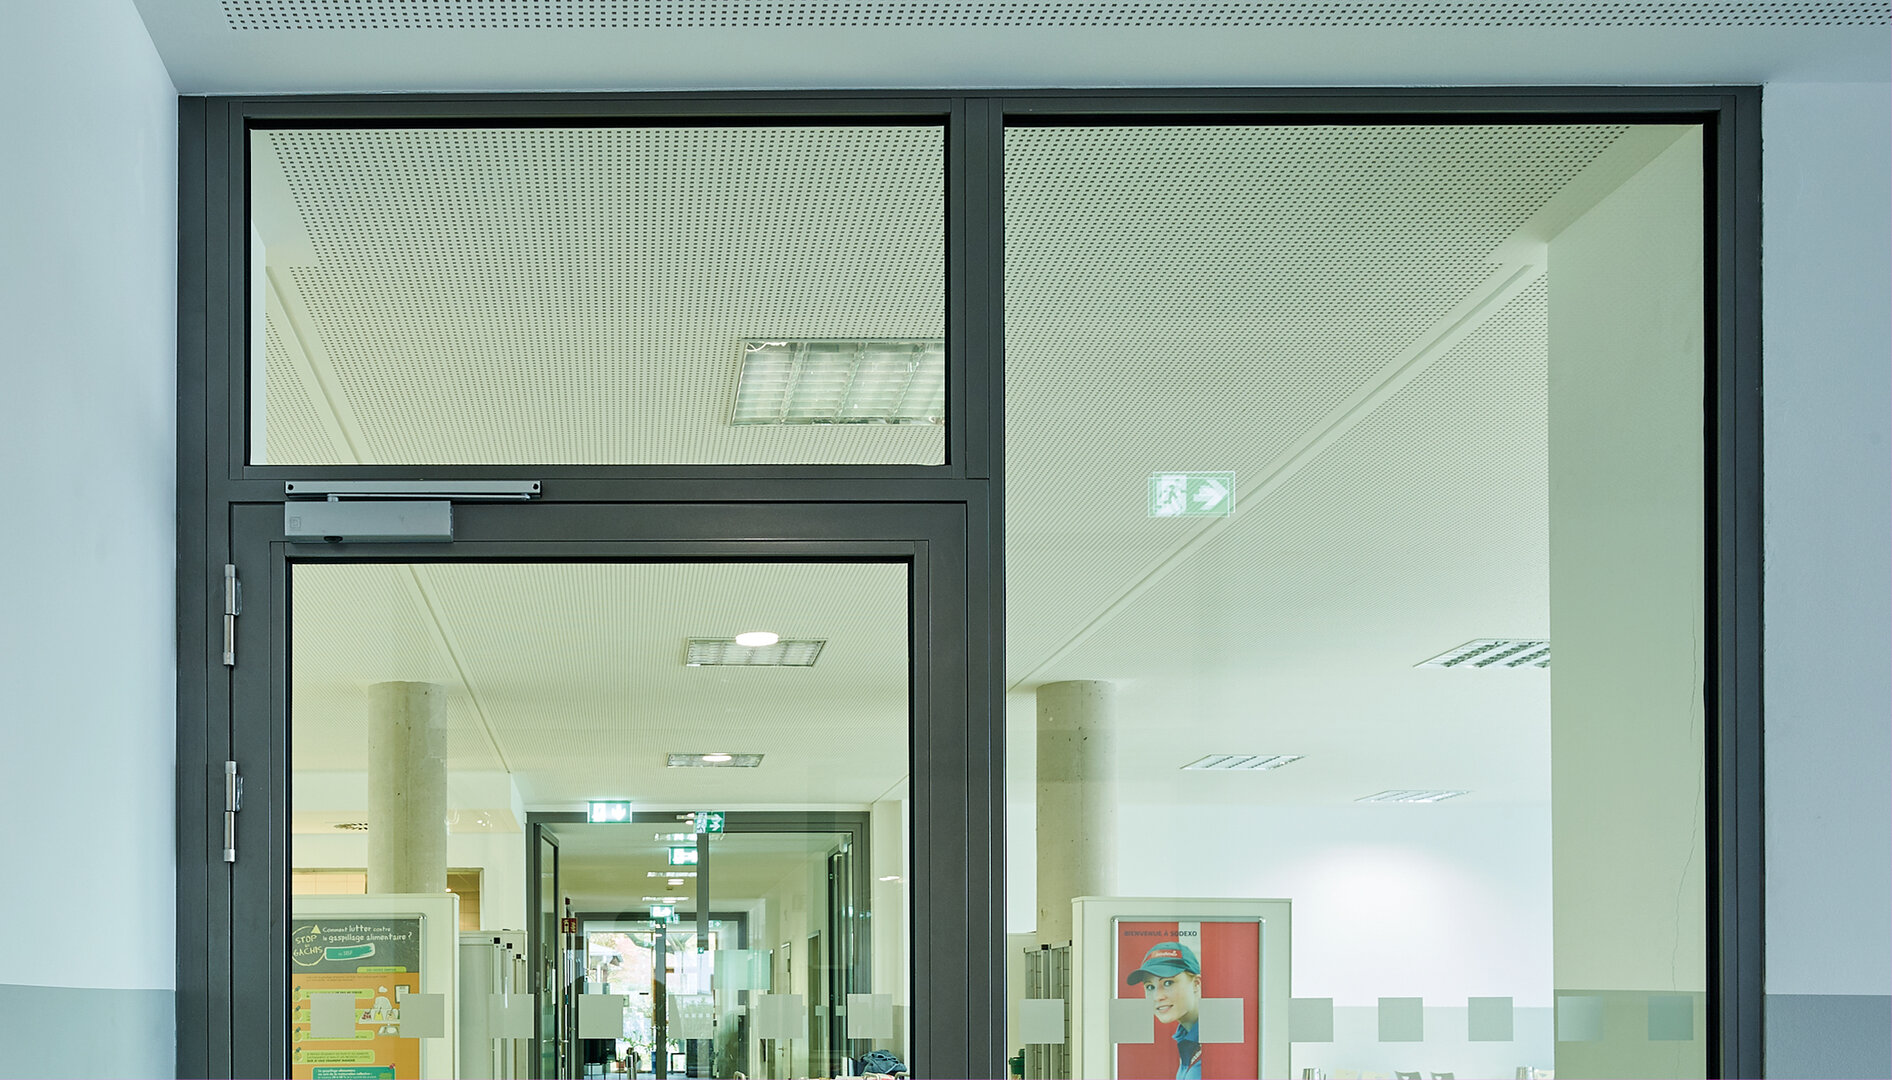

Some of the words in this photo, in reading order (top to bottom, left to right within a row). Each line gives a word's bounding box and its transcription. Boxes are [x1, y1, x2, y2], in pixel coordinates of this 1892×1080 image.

[349, 924, 371, 932] lutter
[295, 934, 318, 944] STOP
[328, 933, 364, 943] gaspillage
[366, 933, 406, 941] alimentaire
